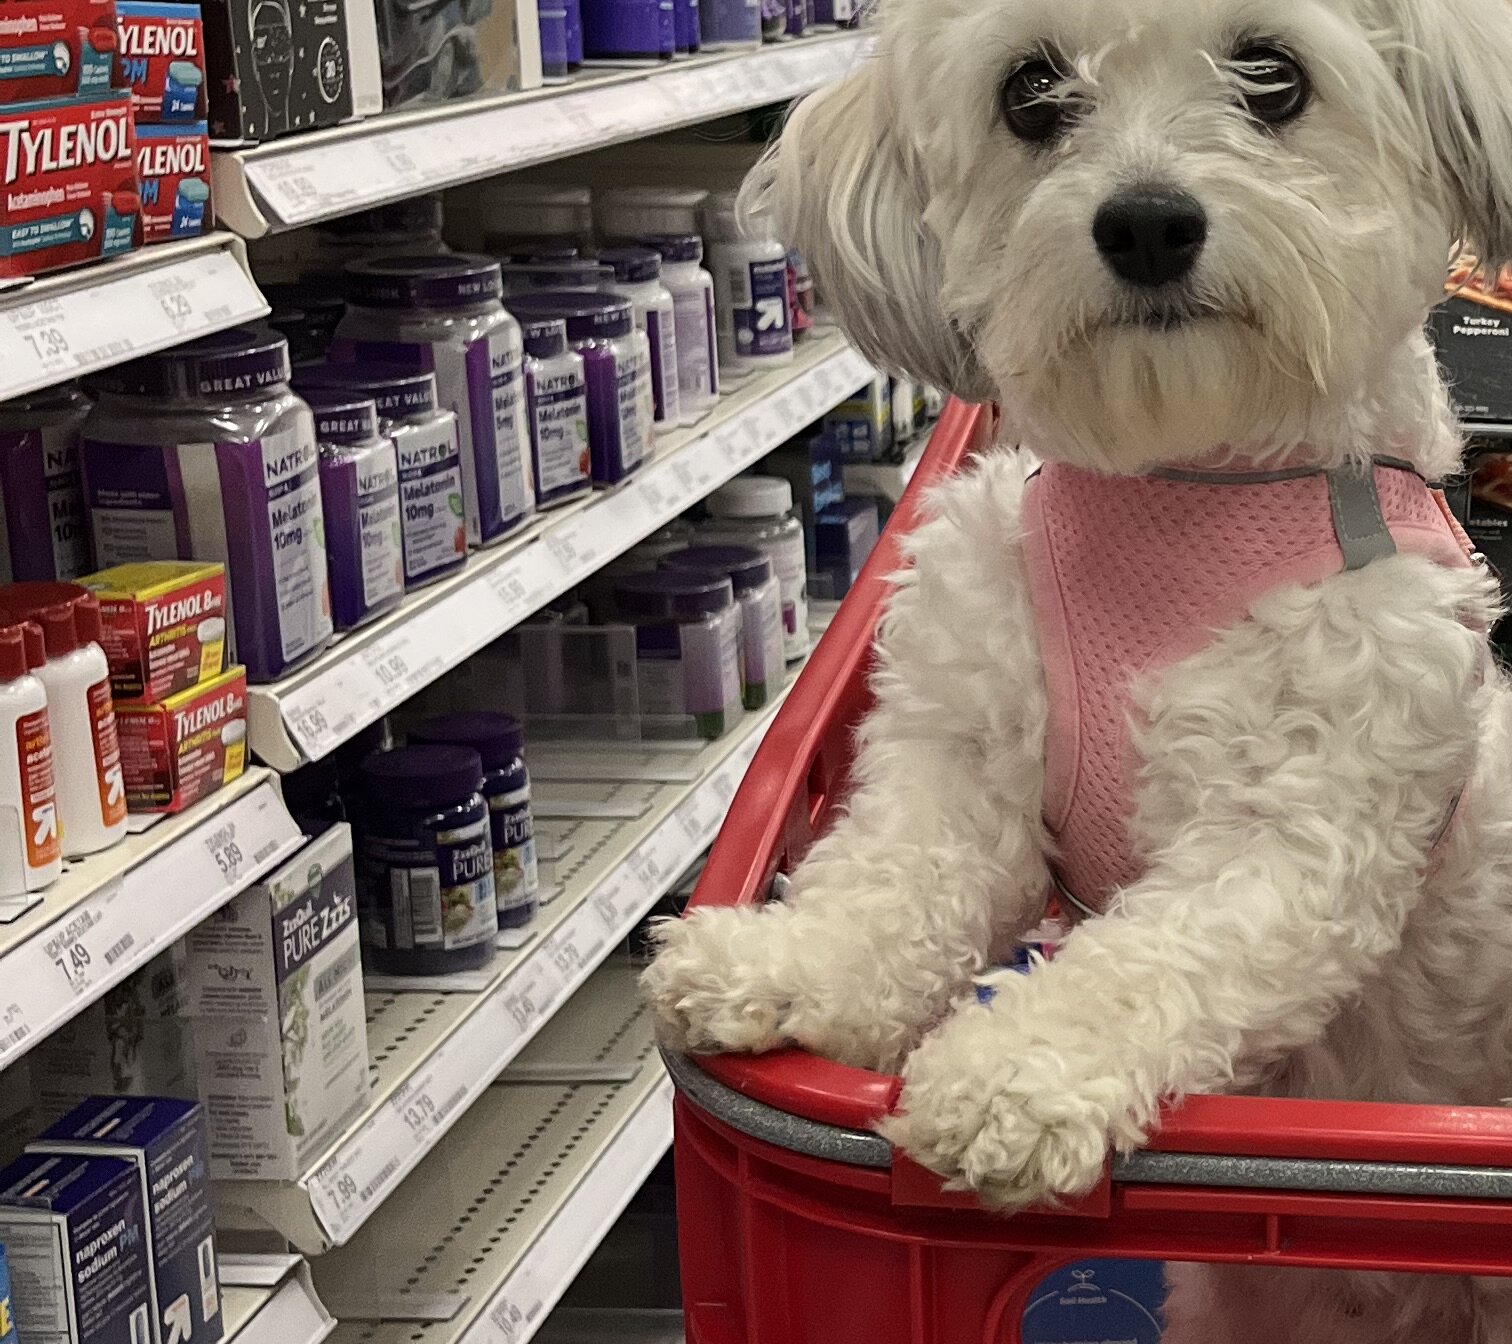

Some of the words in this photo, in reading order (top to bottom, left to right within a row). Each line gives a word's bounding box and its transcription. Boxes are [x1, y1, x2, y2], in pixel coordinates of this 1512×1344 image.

[117, 24, 198, 57] YLENOL
[0, 117, 132, 185] TYLENOL
[137, 143, 205, 177] YLENOL
[1453, 325, 1509, 337] Pepperoni
[1462, 316, 1501, 329] Turkey
[24, 327, 70, 361] 7.39
[199, 374, 252, 394] GREAT
[536, 374, 576, 392] NATRO
[400, 439, 455, 467] NATROL
[403, 474, 455, 501] Melatonin
[405, 503, 434, 524] 10mg
[274, 526, 304, 551] 10mg
[145, 593, 200, 636] TYLENOL
[174, 696, 226, 743] TYLENOL
[452, 853, 492, 882] PURE
[283, 914, 320, 970] PURE
[55, 942, 92, 982] 7.49
[152, 1154, 195, 1196] naproxen
[154, 1179, 189, 1216] sodium
[76, 1218, 127, 1265] naproxen
[77, 1245, 119, 1285] sodium
